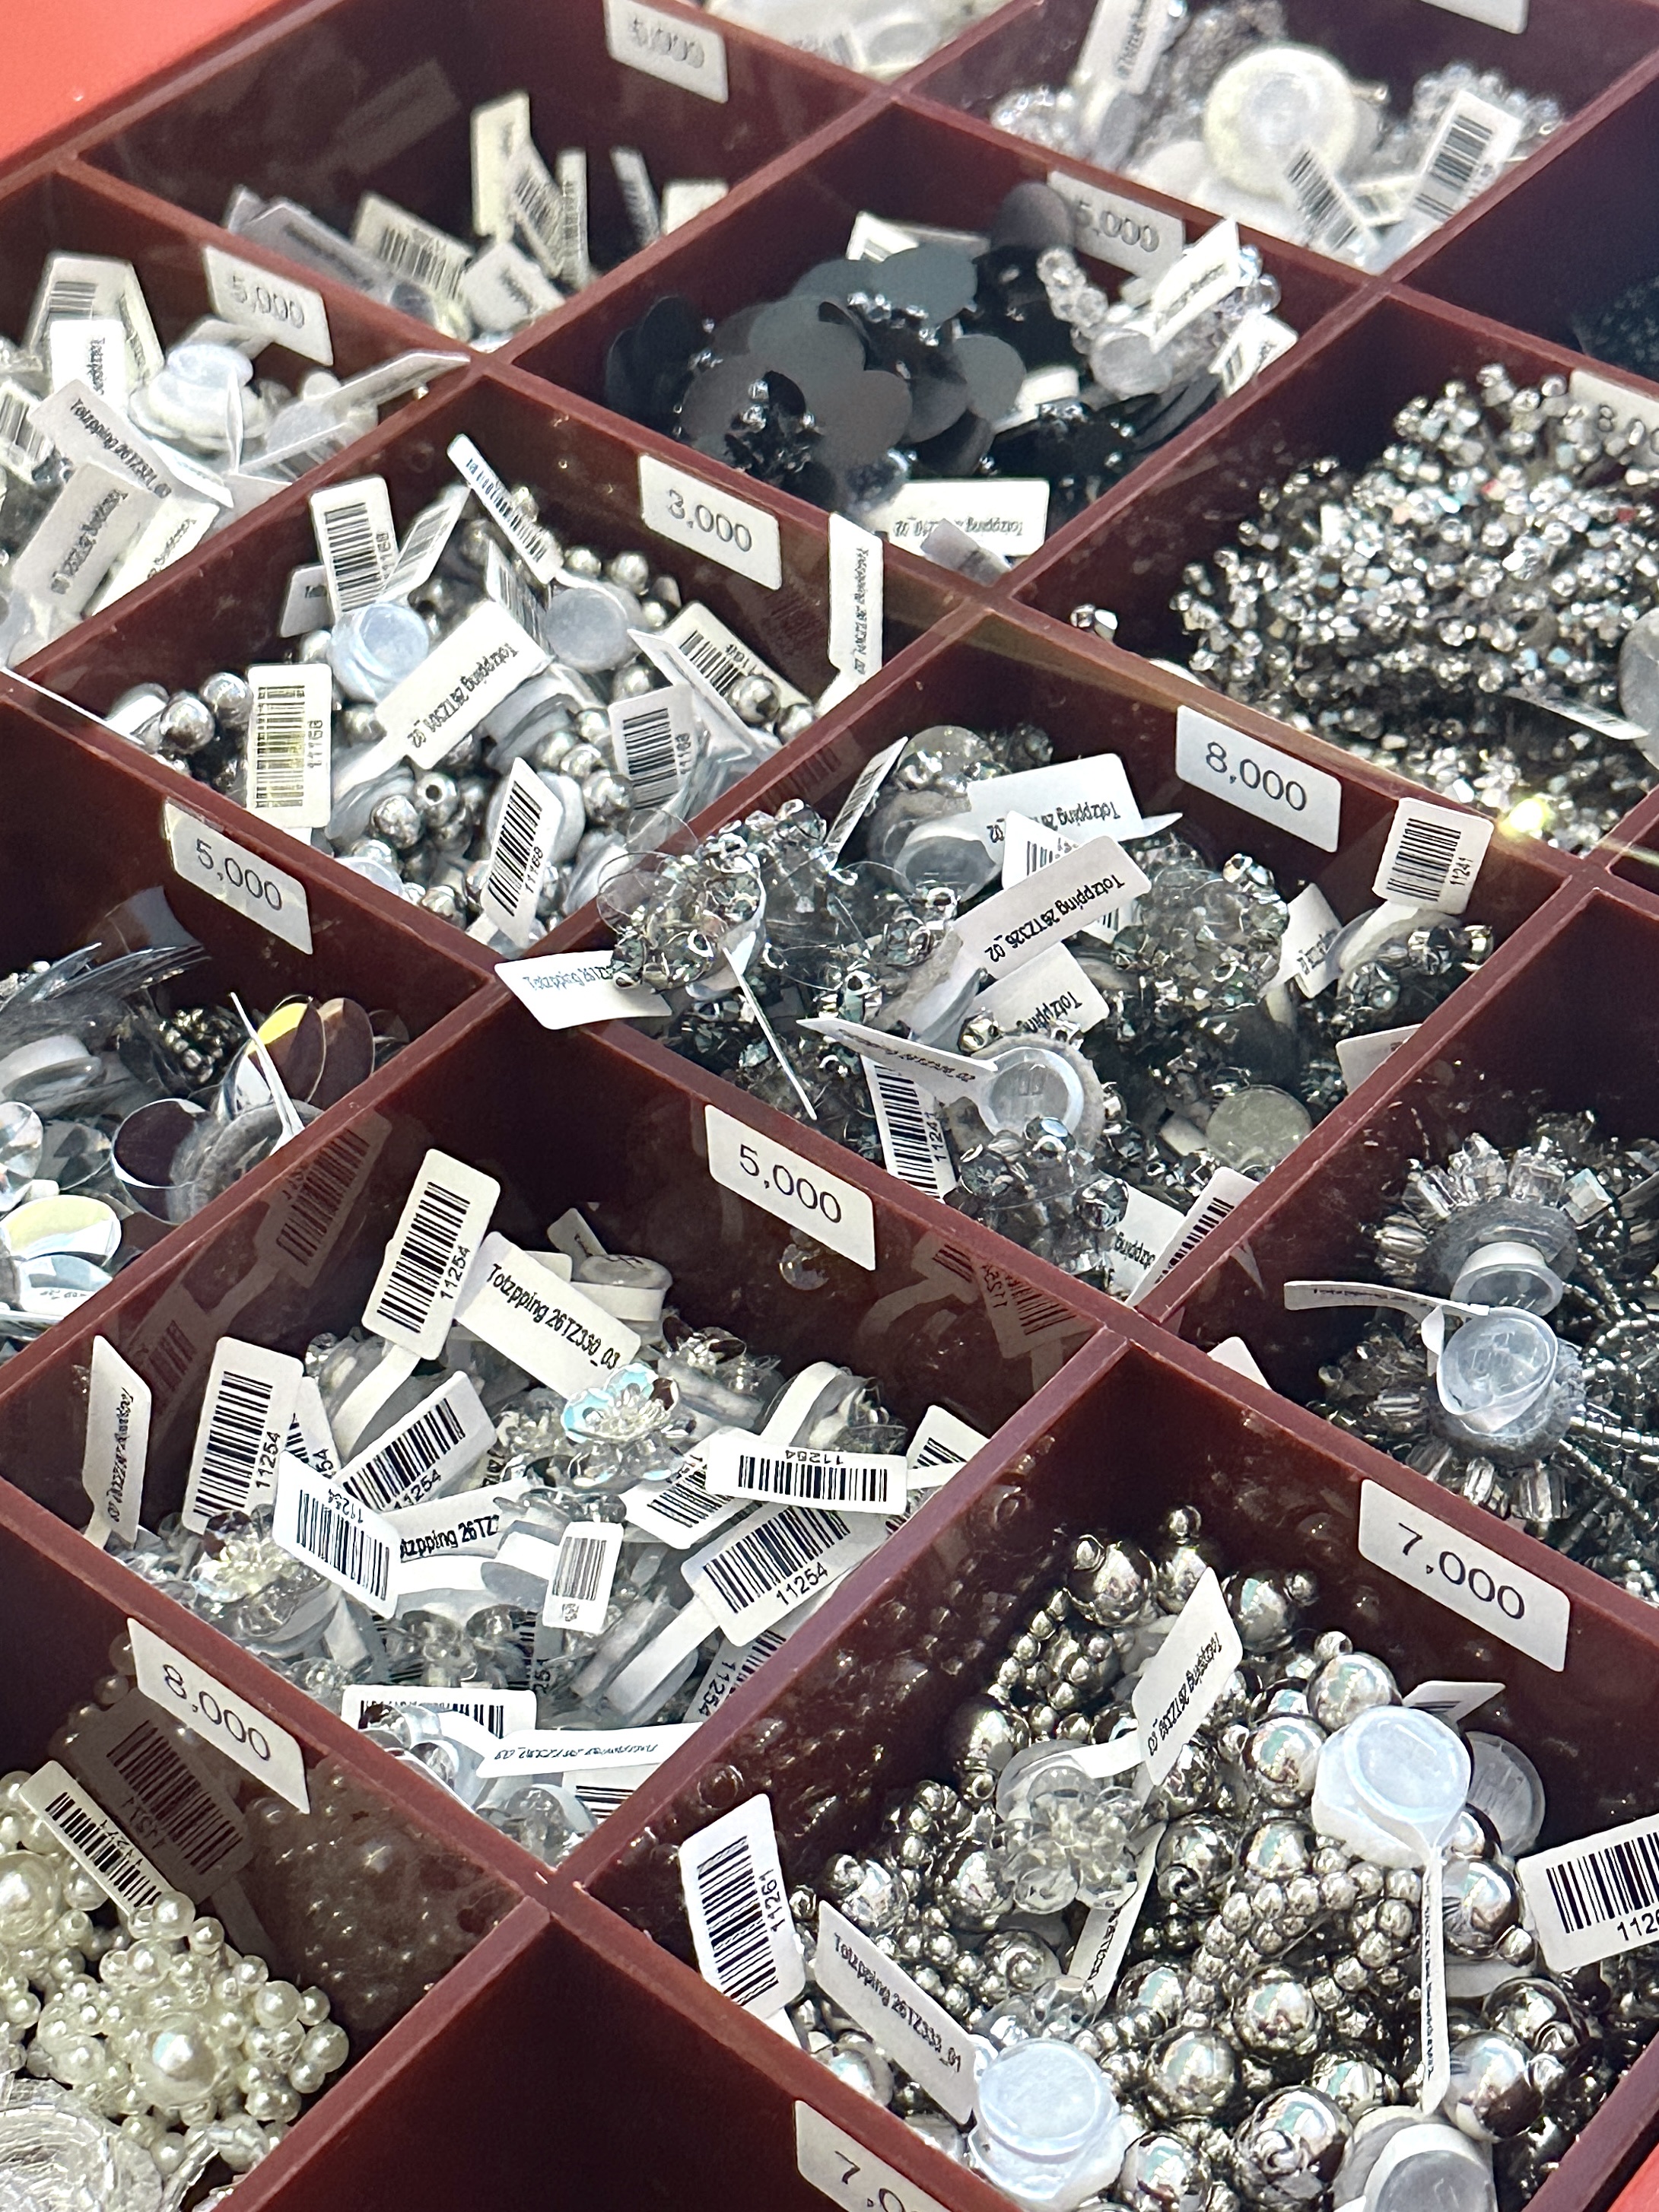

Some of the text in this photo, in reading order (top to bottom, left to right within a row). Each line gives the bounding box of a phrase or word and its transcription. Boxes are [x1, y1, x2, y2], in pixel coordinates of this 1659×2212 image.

[230, 273, 306, 330] 5,000
[667, 488, 752, 552] 3,000
[1204, 739, 1308, 813] 8,000
[195, 838, 283, 911] 5,000
[1054, 874, 1126, 916] Totzpping
[925, 1111, 946, 1163] 11241
[739, 1143, 841, 1225] 5,000
[440, 1245, 471, 1299] 11254
[486, 1263, 550, 1324] Totzpping
[255, 1431, 281, 1489] 11254
[776, 1562, 828, 1606] 11254
[1397, 1522, 1525, 1621] 7,000
[161, 1663, 272, 1762] 8,000
[698, 1661, 736, 1717] 11254
[758, 1869, 786, 1933] 11261
[834, 2150, 917, 2212] 7,0
